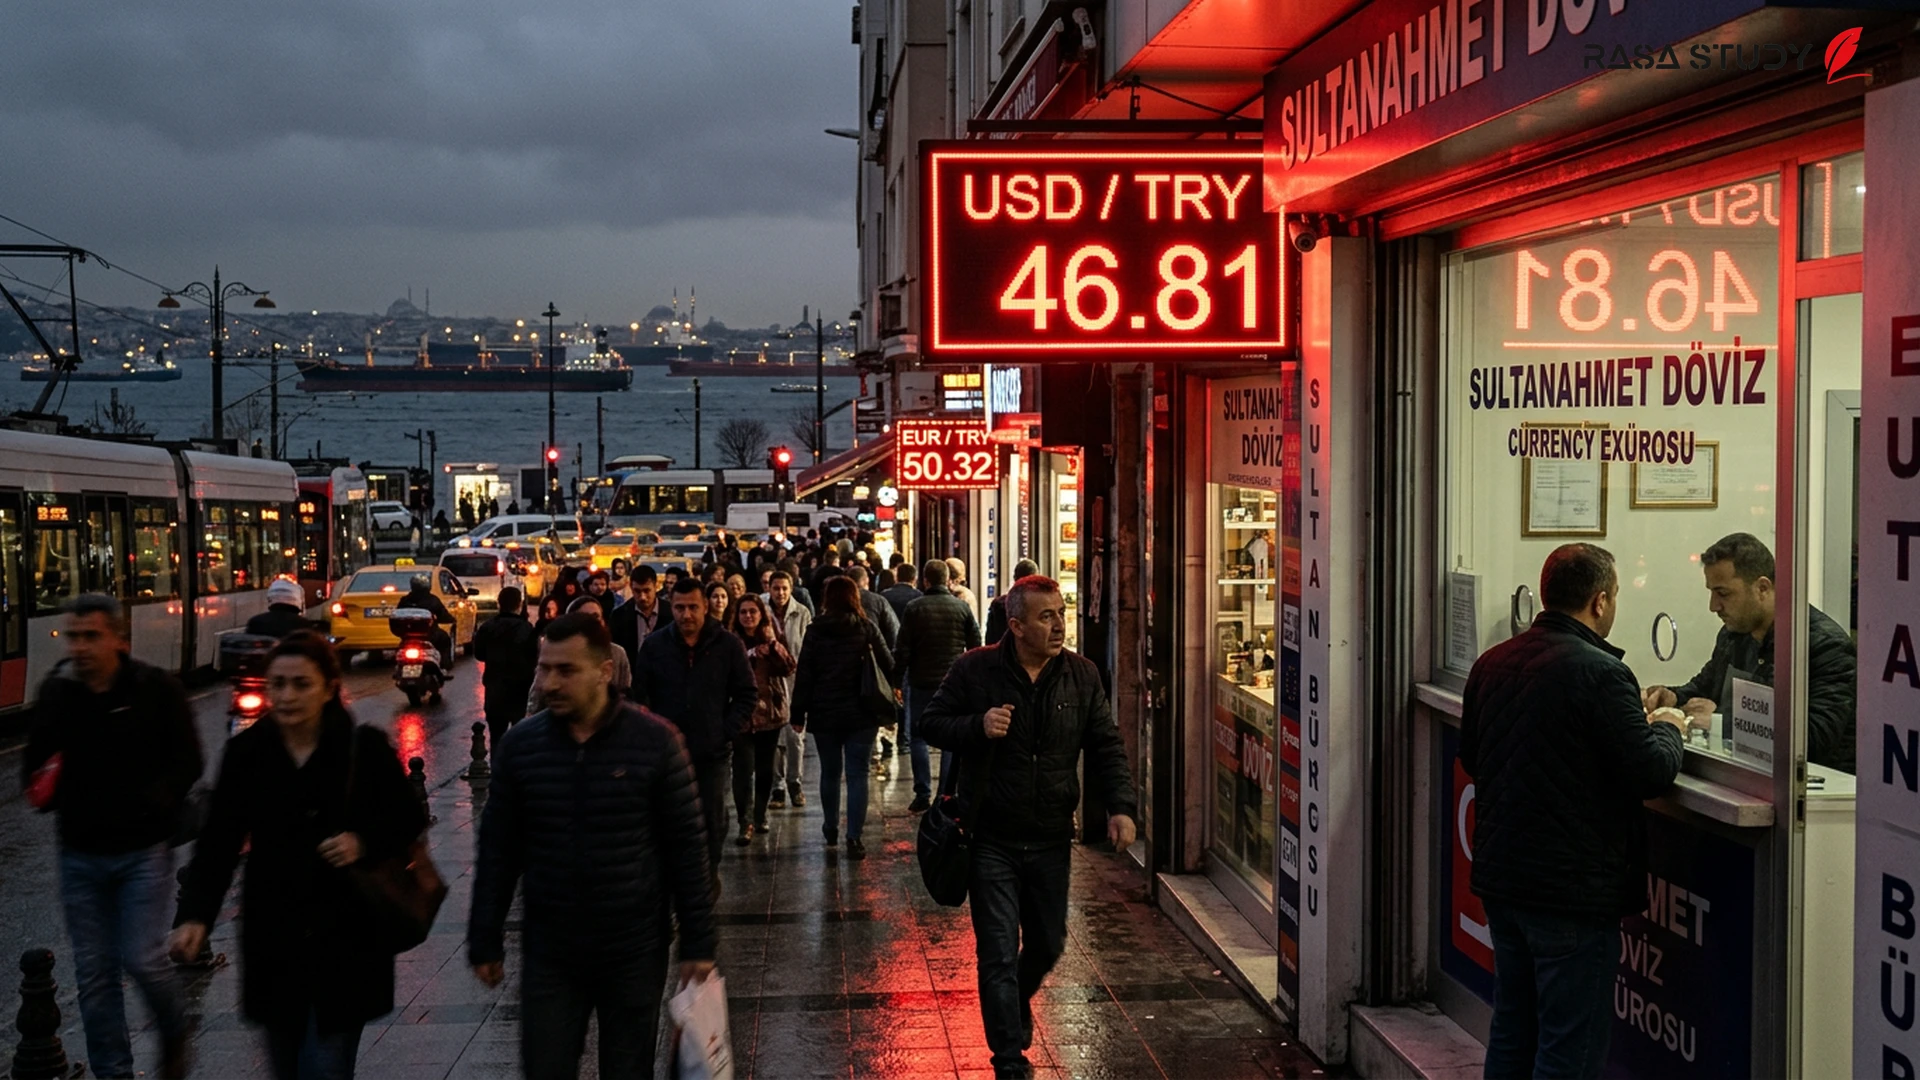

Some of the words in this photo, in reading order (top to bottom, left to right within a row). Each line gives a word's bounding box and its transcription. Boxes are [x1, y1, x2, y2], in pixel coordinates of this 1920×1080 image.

[964, 174, 1083, 220] USD
[1100, 174, 1119, 220] /
[1134, 174, 1251, 220] TRY
[1000, 244, 1257, 331] 46.81
[1469, 356, 1653, 409] SULTANAHMET
[1663, 336, 1766, 406] DÖVİZ
[902, 429, 940, 446] EUR
[944, 429, 952, 446] /
[955, 429, 990, 446] TRY
[902, 451, 992, 482] 50.32
[1508, 428, 1595, 460] CURRENCY
[1600, 423, 1695, 465] EXÜROSU
[1308, 378, 1321, 639] SULTAN
[1642, 872, 1711, 946] MET
[1614, 973, 1696, 1062] ÜROSU
